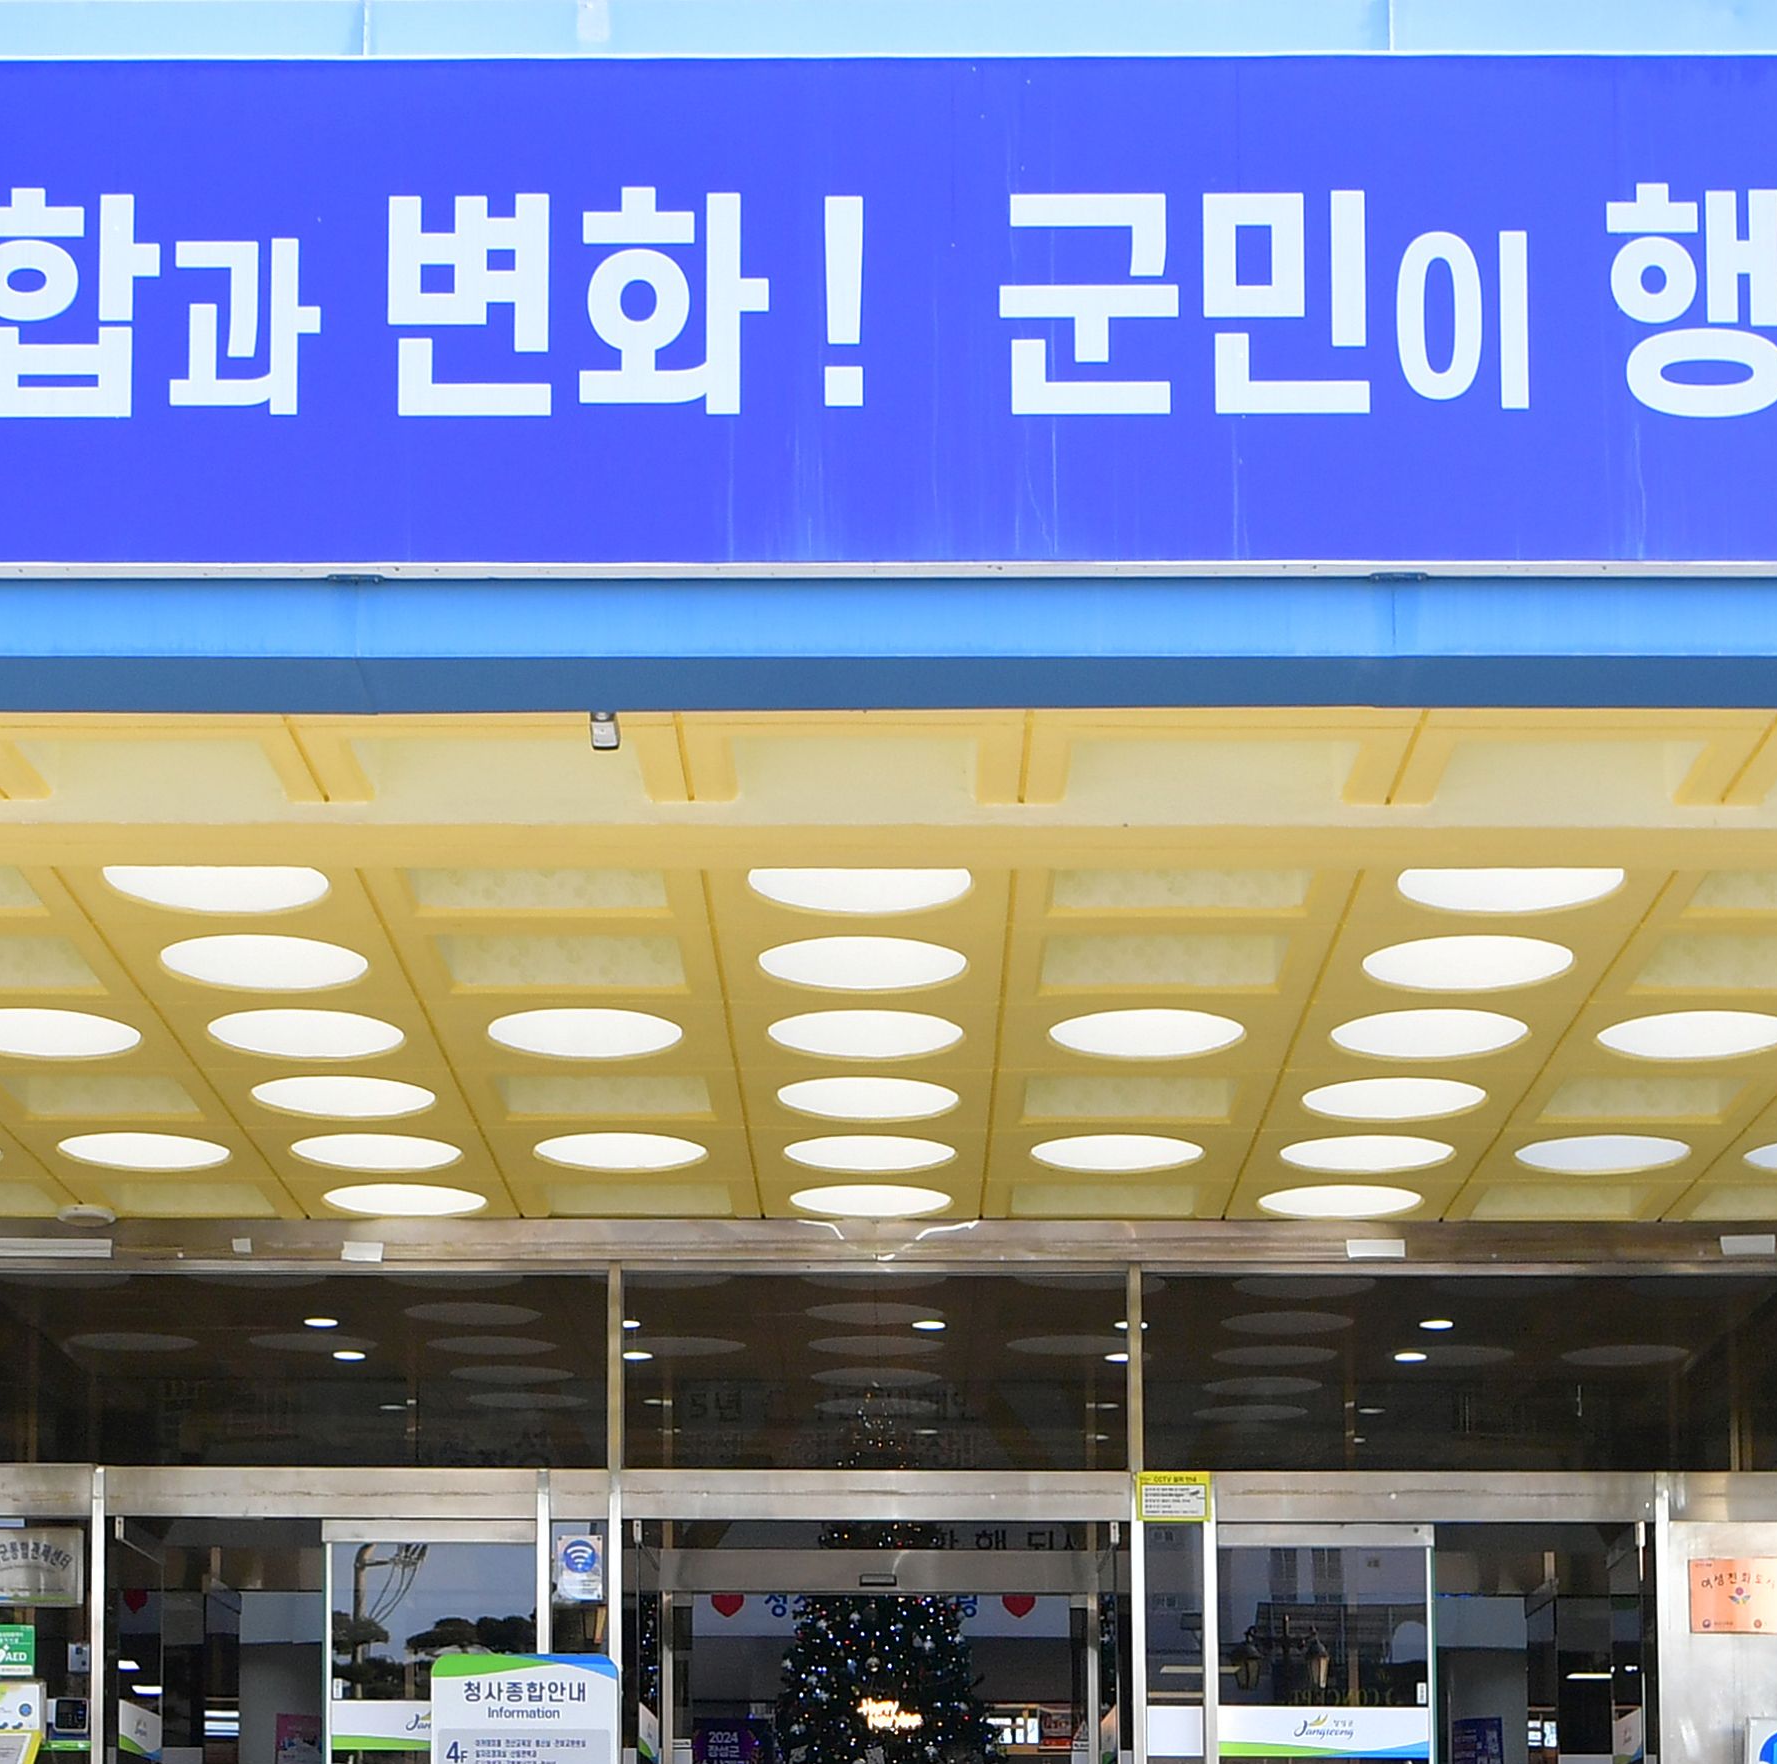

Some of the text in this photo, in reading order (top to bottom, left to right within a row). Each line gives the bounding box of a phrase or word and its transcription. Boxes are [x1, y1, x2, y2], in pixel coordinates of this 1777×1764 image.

[999, 189, 1530, 415] 군민이
[5, 1652, 27, 1662] AED
[463, 1681, 586, 1703] 청사종합안내
[487, 1706, 560, 1719] Information
[708, 1730, 739, 1744] 2024
[446, 1741, 468, 1764] 4F
